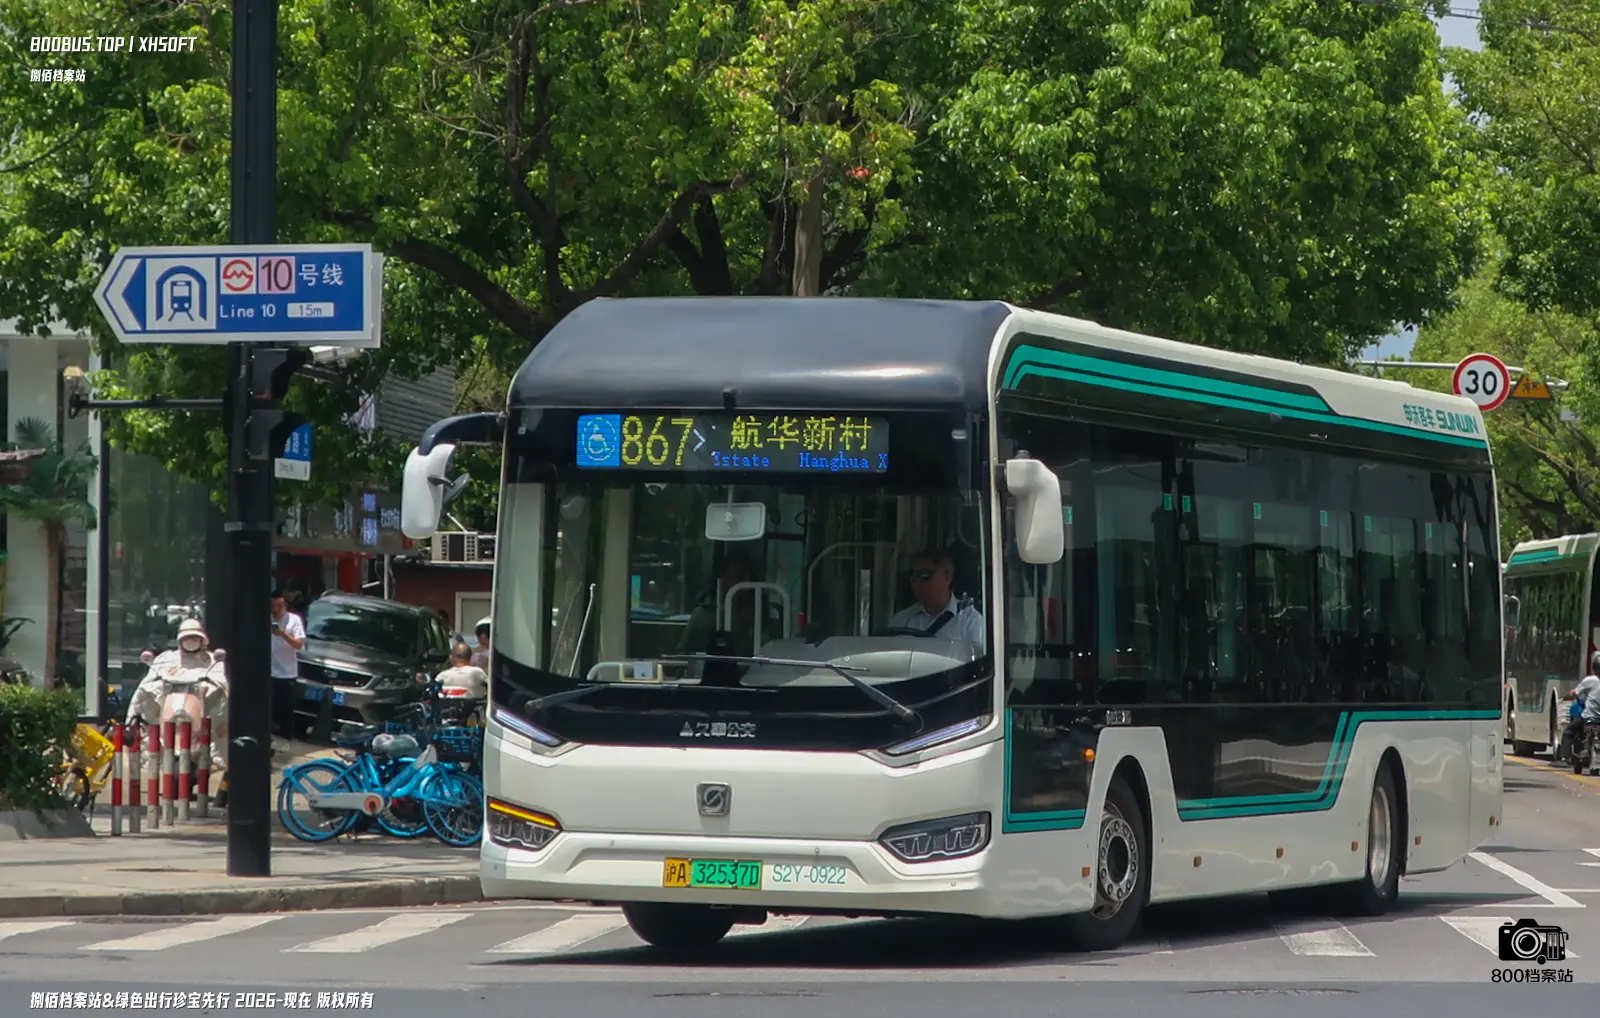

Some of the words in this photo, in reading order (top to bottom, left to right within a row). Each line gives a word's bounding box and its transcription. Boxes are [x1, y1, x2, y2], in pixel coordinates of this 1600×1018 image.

[261, 259, 293, 292] 10
[299, 264, 344, 286] 号线
[219, 305, 255, 319] Line
[260, 304, 277, 318] 10
[298, 304, 323, 317] 15m
[1465, 369, 1498, 396] 30
[621, 415, 694, 466] 867
[730, 415, 873, 451] 航华新村
[799, 451, 869, 471] Hanghua
[695, 863, 760, 886] 32537D
[771, 864, 847, 885] S2Y-0922
